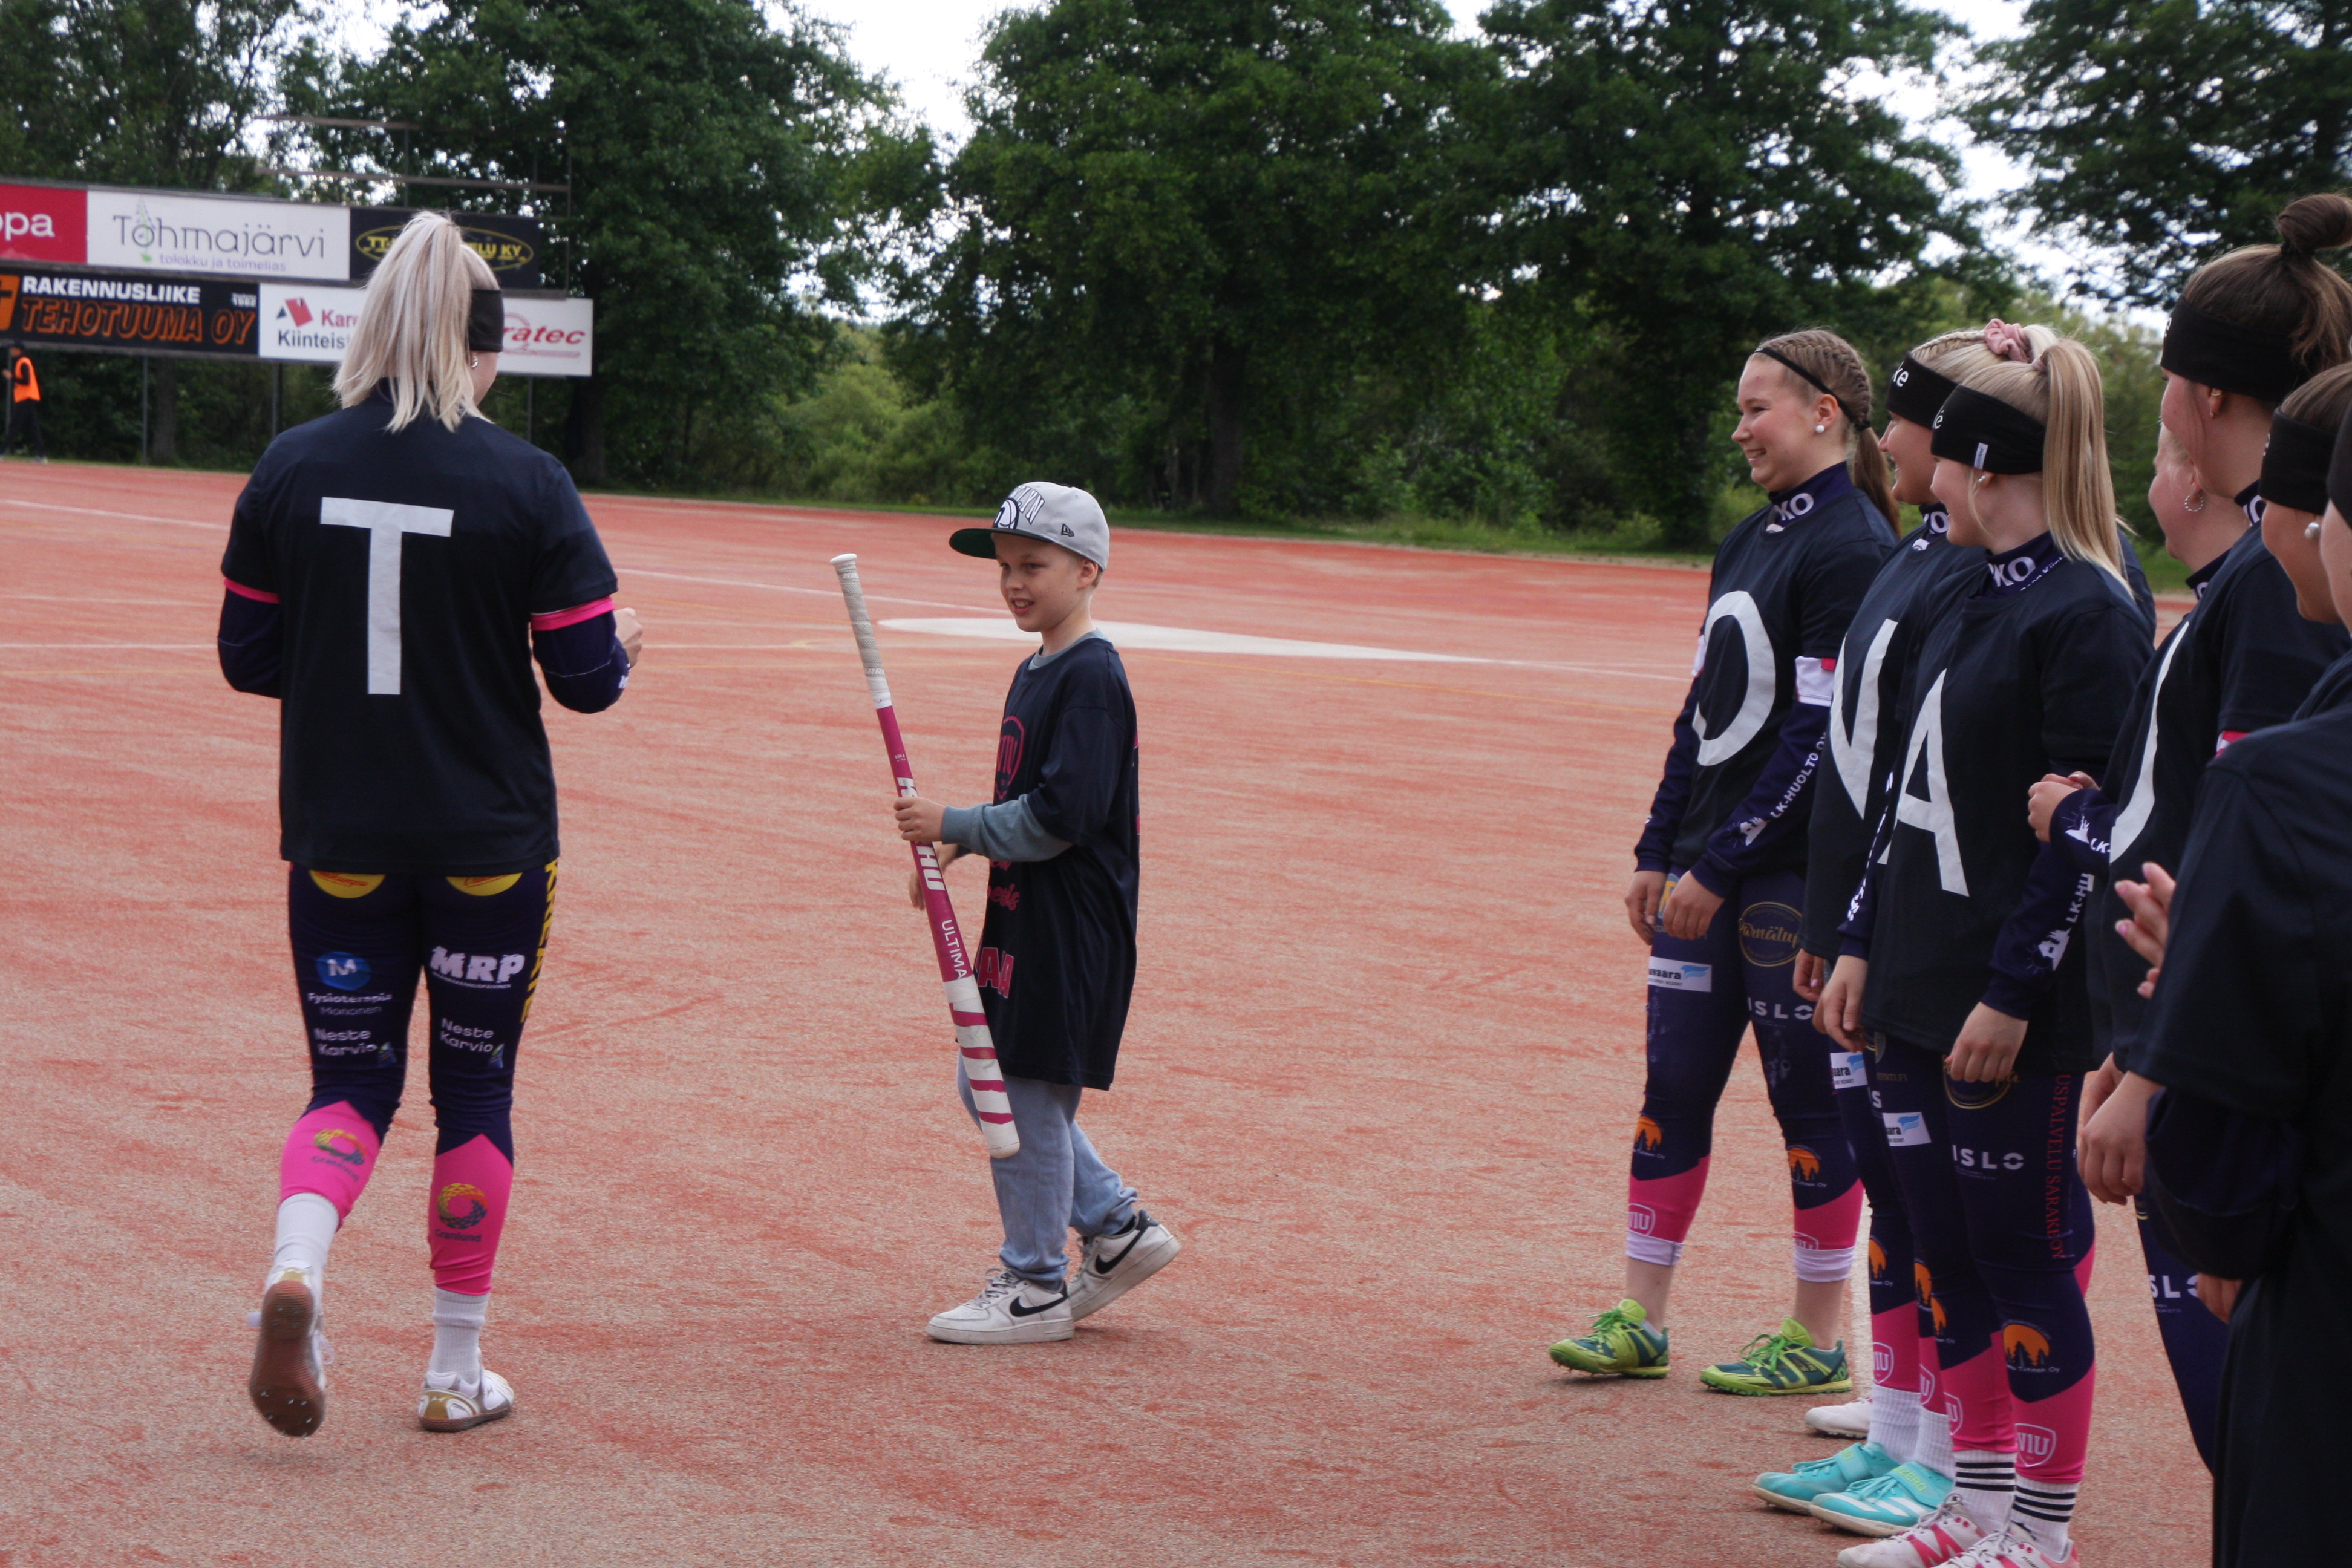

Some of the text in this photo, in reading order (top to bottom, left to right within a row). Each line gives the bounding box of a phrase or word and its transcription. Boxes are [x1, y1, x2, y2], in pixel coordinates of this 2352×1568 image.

[0, 212, 56, 241] pa
[113, 214, 325, 258] Tohmajärvi
[160, 253, 287, 272] tolokku ja toimelias
[501, 244, 521, 256] KY
[22, 276, 201, 304] RAKENNUSLIIKE
[22, 296, 204, 343] TEHOTUUMA
[211, 308, 256, 345] OY
[319, 497, 455, 695] T
[1770, 752, 1819, 818] LK-HUOLTO
[1877, 668, 1970, 897] A
[1739, 918, 1799, 949] Pärnätu
[941, 919, 968, 980] ULTIMA
[430, 945, 526, 984] MRP
[307, 992, 393, 1004] Fysioterapia
[314, 1028, 372, 1041] Neste
[440, 1030, 494, 1053] Karvio
[442, 1018, 494, 1039] Neste
[317, 1042, 379, 1056] Karvio
[2046, 1074, 2072, 1171] USPALVELU
[434, 1228, 482, 1243] Granlund
